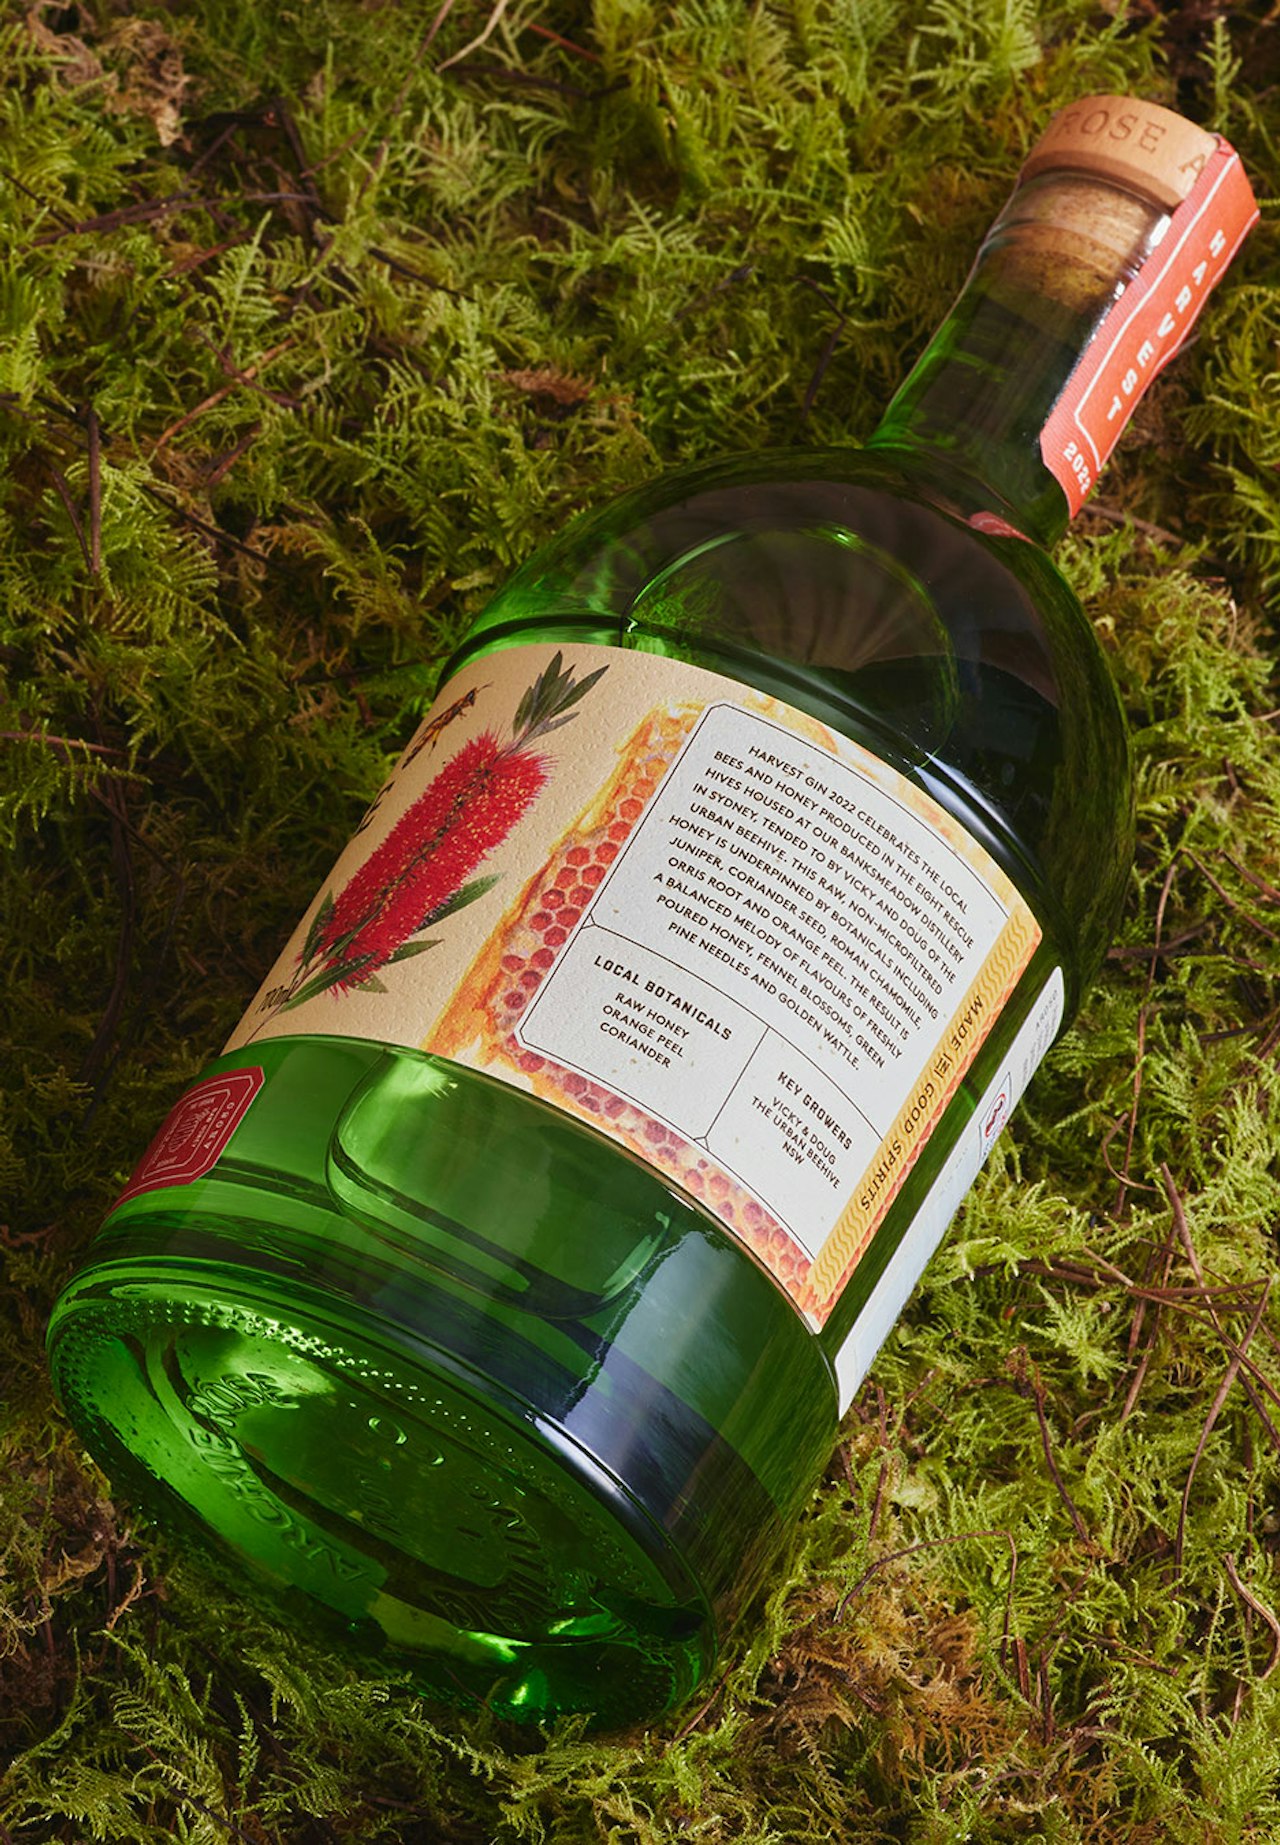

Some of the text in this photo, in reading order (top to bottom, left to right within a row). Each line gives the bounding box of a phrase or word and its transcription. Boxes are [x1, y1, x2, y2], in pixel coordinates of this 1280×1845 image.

[1054, 109, 1167, 154] ROSE
[1106, 230, 1226, 422] HARVEST
[1062, 441, 1092, 495] 2022
[705, 767, 964, 964] HIVES HOUSED AT OUR BANKSMEADOW DISTILLERY
[714, 750, 974, 949] BEES AND HONEY PRODUCED IN THE EIGHT RESCUE
[748, 746, 967, 915] HARVEST GIN 2022 CELEBRATES THE LOCAL
[668, 814, 938, 1020] HONEY IS UNDERPINNED BY BOTANICALS INCLUDING
[690, 802, 942, 995] URBAN BEEHIVE. THIS RAW, NON-MICROFILTERED
[692, 783, 956, 984] IN SYDNEY, TENDED TO BY VICKY AND DOUG OF THE
[653, 873, 902, 1059] A BALANCED MELODY OF FLAVOURS OF FRESHLY
[668, 857, 909, 1040] ORRIS ROOT AND ORANGE PEEL. THE RESULT IS
[669, 837, 921, 1030] JUNIPER, CORIANDER SEED, ROMAN CHAMOMILE,
[594, 955, 732, 1040] LOCAL BOTANICALS
[615, 992, 690, 1039] RAW HONEY
[656, 894, 885, 1068] POURED HONEY, FENNEL BLOSSOMS, GREEN
[668, 922, 859, 1070] PINE NEEDLES AND GOLDEN WATTLE.
[951, 995, 983, 1052] MADE
[600, 1022, 671, 1068] CORIANDER
[602, 1005, 683, 1058] ORANGE PEEL
[752, 1096, 840, 1189] THE URBAN BEEHIVE
[773, 1097, 836, 1165] VICKY & DOUG
[777, 1071, 852, 1150] KEY GROWERS
[782, 1141, 805, 1164] NSW
[904, 1082, 935, 1134] GOOD
[861, 1139, 902, 1211] SPIRITS
